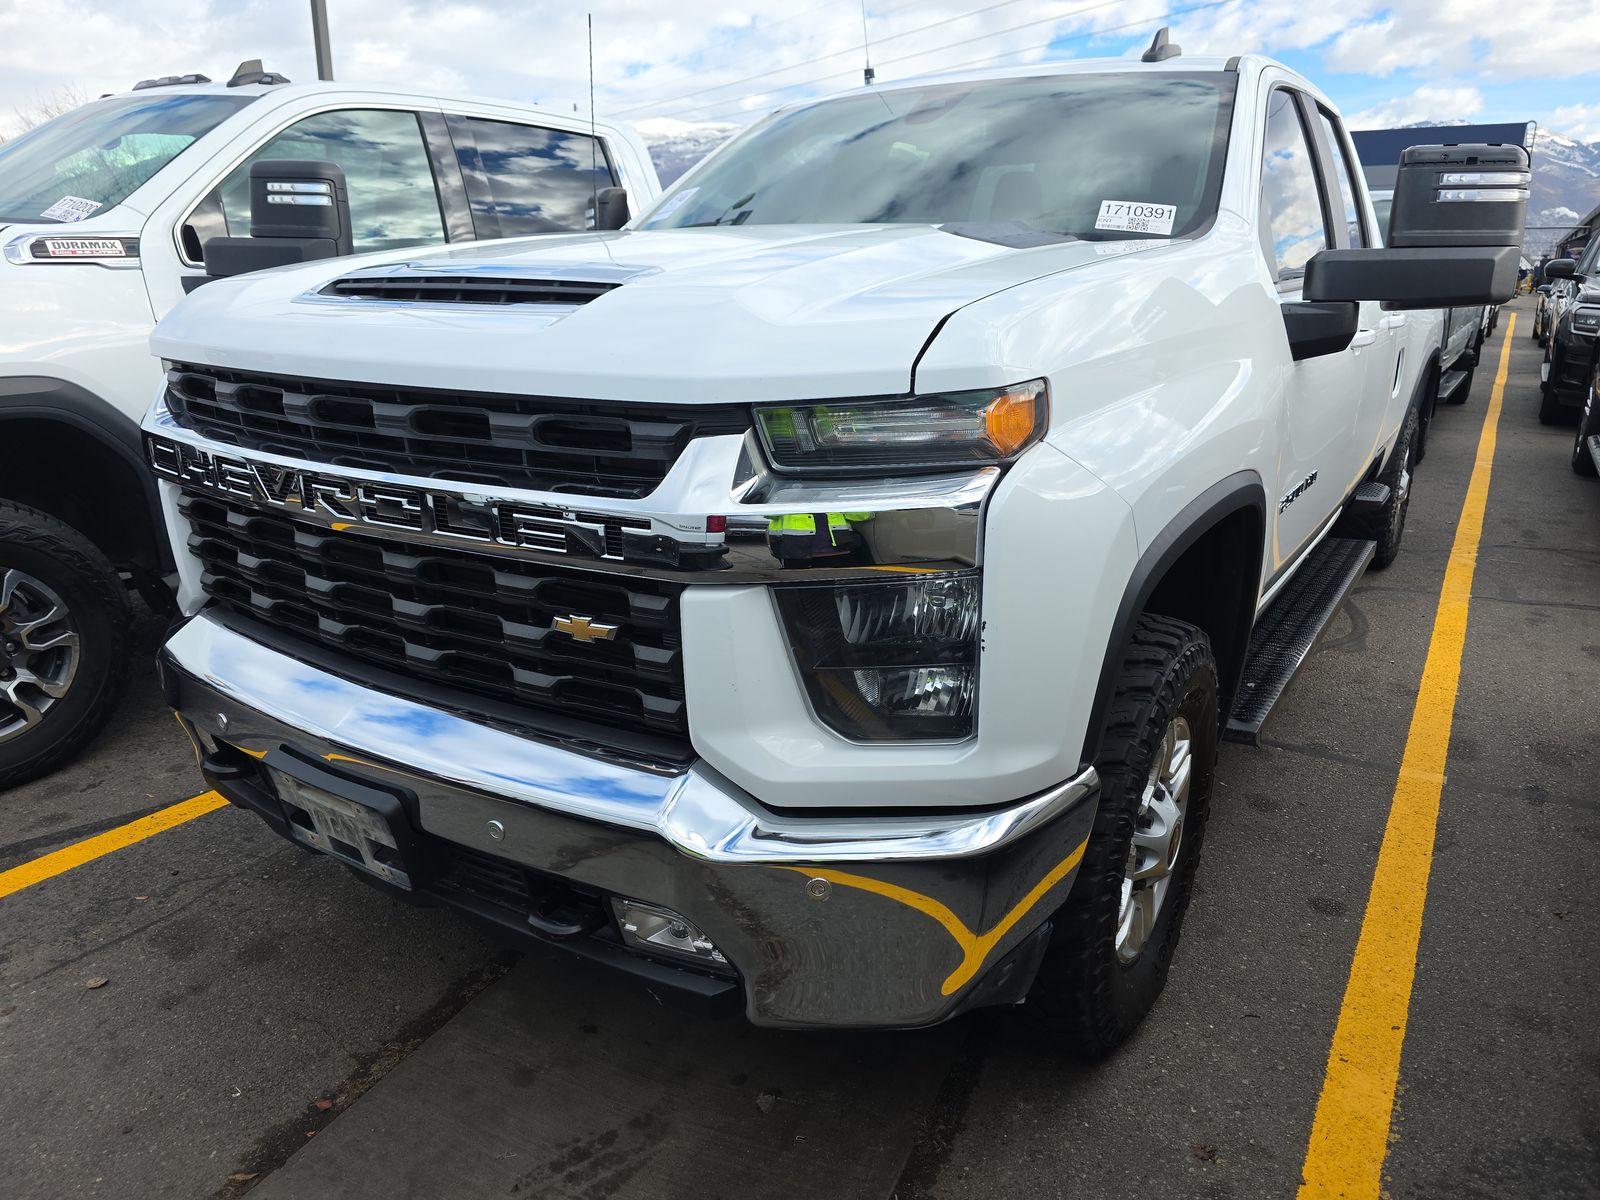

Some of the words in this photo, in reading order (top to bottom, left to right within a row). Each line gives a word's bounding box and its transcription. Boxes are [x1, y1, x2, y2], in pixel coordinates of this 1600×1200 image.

[1104, 203, 1173, 220] 1710391
[51, 240, 118, 250] DURAMAX
[147, 437, 651, 561] CHEVROLET
